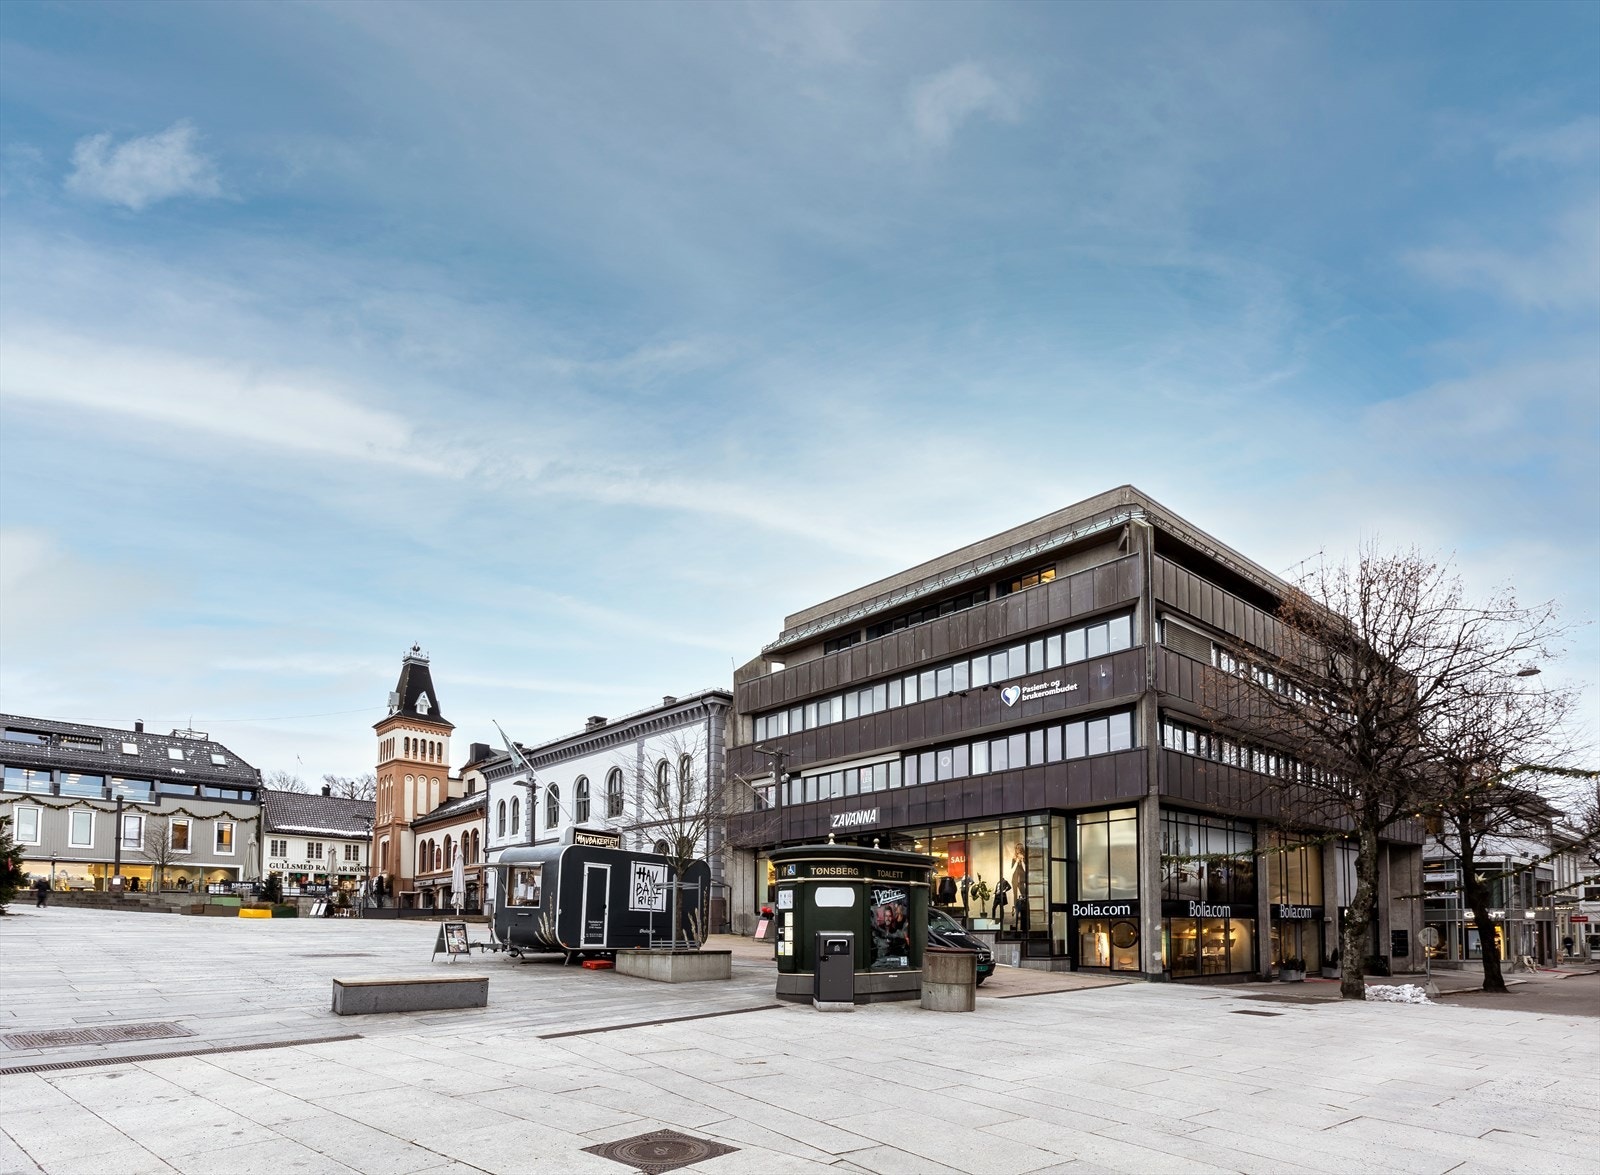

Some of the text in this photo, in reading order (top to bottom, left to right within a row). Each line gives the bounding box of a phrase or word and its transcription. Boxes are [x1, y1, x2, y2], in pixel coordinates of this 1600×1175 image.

[1022, 682, 1049, 693] Pasient-
[1022, 683, 1078, 701] brukerombudet
[832, 809, 876, 828] ZAVANNA
[269, 862, 314, 871] GULLSMED
[636, 866, 659, 883] HAV
[810, 867, 904, 878] TØNSBERG TOALETT
[1072, 903, 1131, 916] Bolia.com
[1189, 900, 1231, 918] Bolia.com
[1279, 903, 1312, 919] Bolia.com
